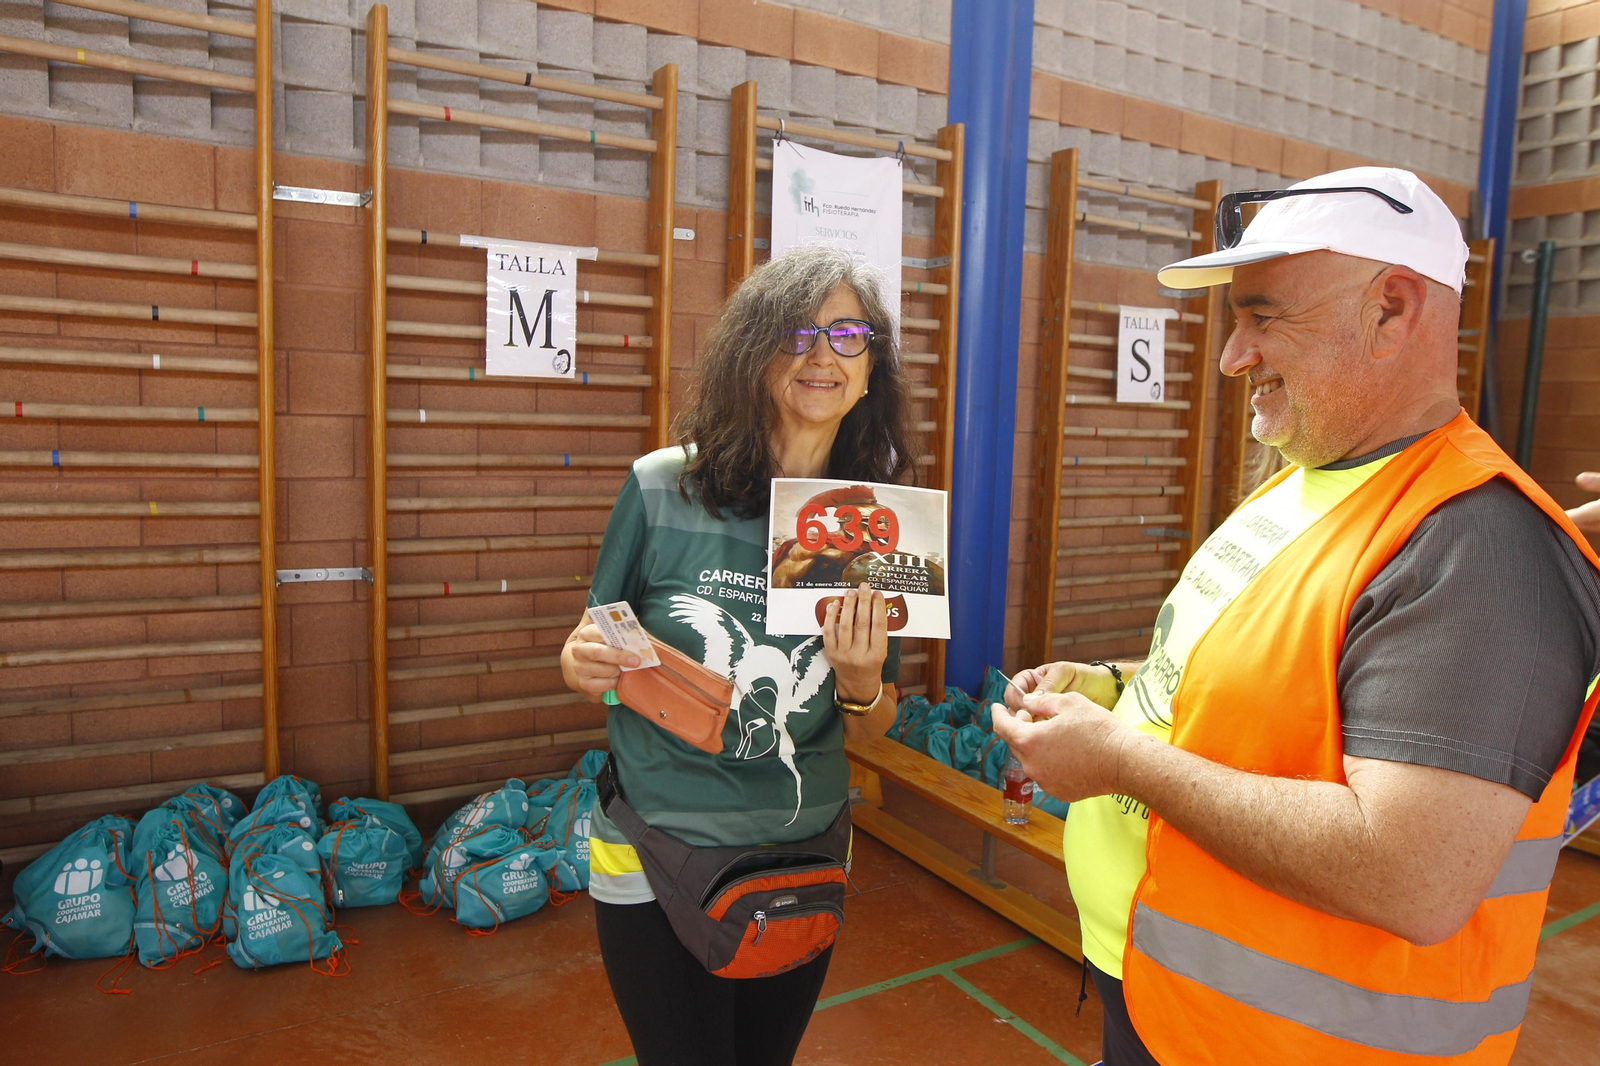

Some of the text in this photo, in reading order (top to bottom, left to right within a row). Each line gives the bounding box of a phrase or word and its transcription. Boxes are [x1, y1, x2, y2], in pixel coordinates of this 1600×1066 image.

[822, 209, 859, 217] FISIOTERAPIA
[815, 226, 858, 241] SERVICIOS
[495, 253, 566, 276] TALLA
[503, 286, 558, 349] M
[1124, 316, 1160, 331] TALLA
[1131, 338, 1152, 383] S
[796, 504, 900, 554] 639
[868, 551, 929, 569] XIII
[1214, 540, 1263, 583] ESPARTAN
[868, 564, 929, 575] CARRERA
[868, 571, 928, 582] POPULAR
[699, 569, 768, 592] CARRER
[868, 582, 929, 593] DEL ALQUIÁN
[881, 578, 929, 587] ESPARTANOS
[696, 585, 768, 606] CD. ESPARTA
[751, 612, 762, 623] 22
[575, 840, 590, 849] GR
[501, 869, 537, 882] GRUPO
[502, 876, 538, 887] COOPERATIVO
[170, 879, 212, 902] COOPEATIVO
[503, 881, 538, 894] CAJAMAR
[57, 893, 101, 910] GRUPO
[55, 909, 101, 924] CAJAMAR
[56, 903, 101, 916] COOPERATIVO
[247, 914, 291, 932] COOPERATIVO
[249, 920, 293, 940] CAJAMAR
